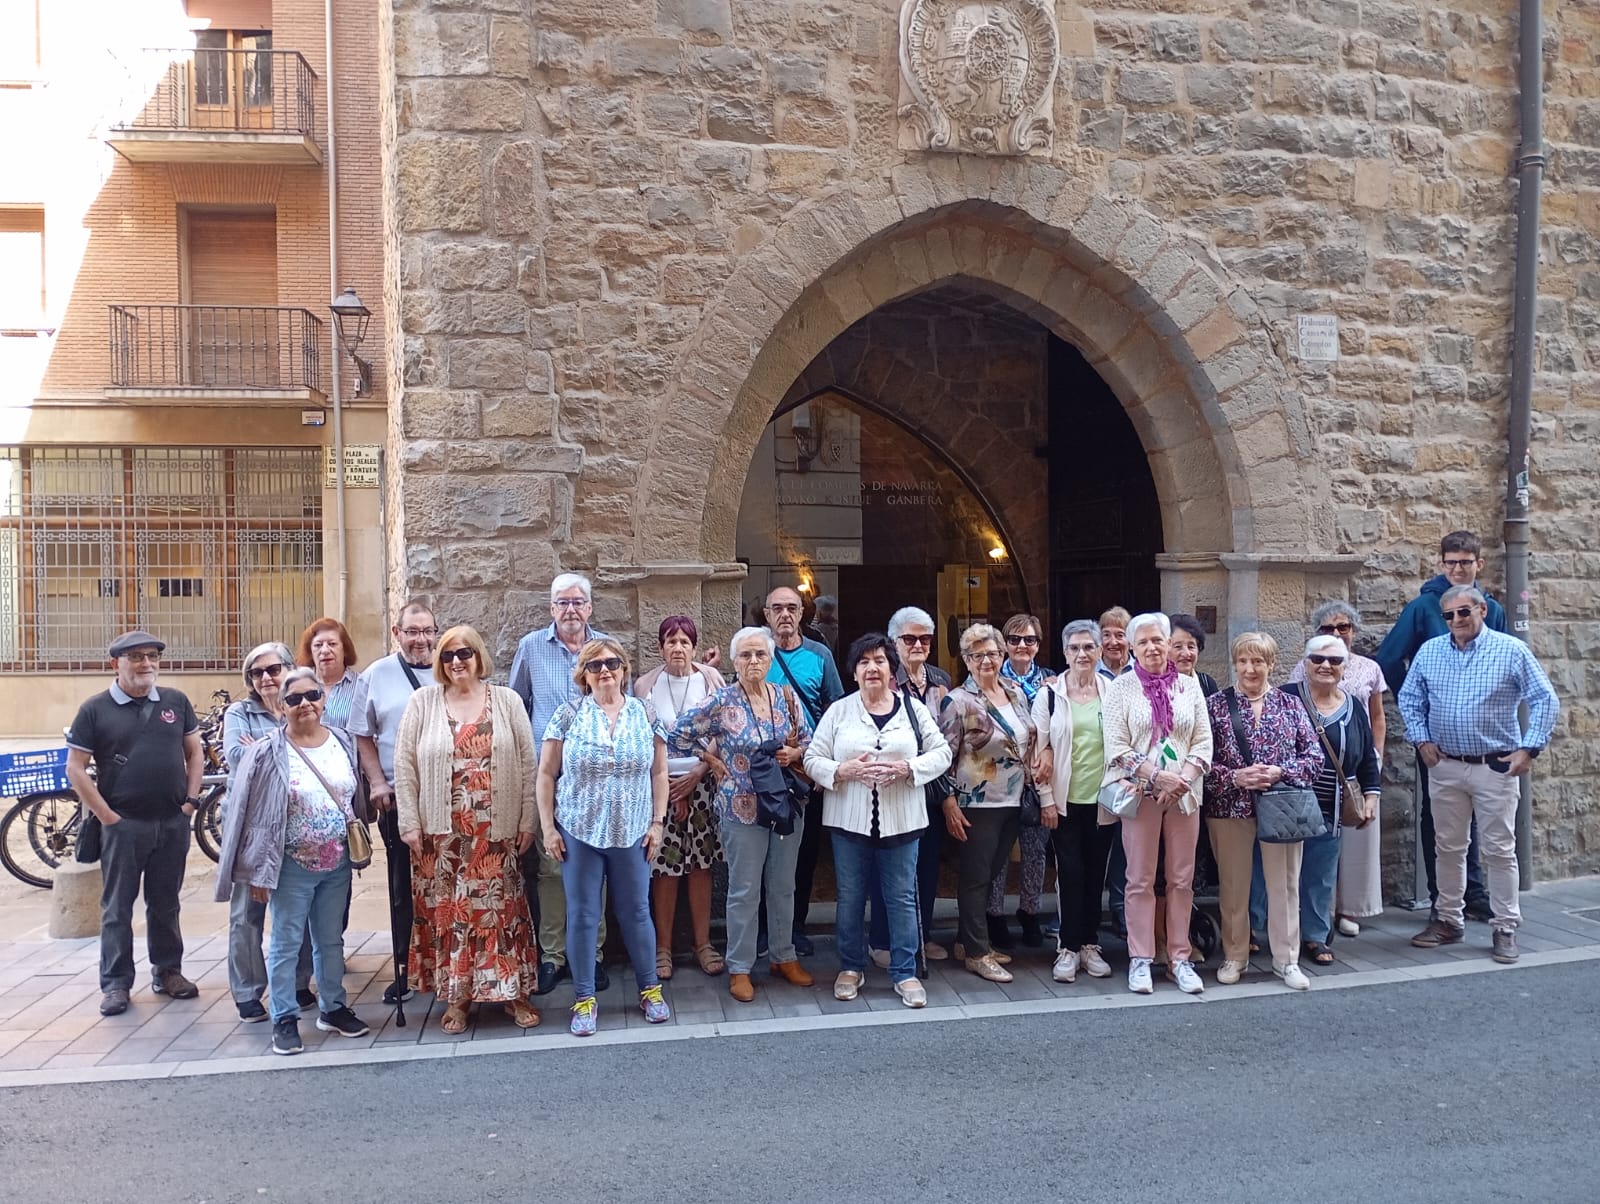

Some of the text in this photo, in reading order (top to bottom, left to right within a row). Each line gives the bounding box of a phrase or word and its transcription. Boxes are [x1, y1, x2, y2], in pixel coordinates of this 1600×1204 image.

[872, 480, 886, 490] DE
[891, 480, 943, 490] NAVARRA
[886, 495, 944, 505] GANBERA
